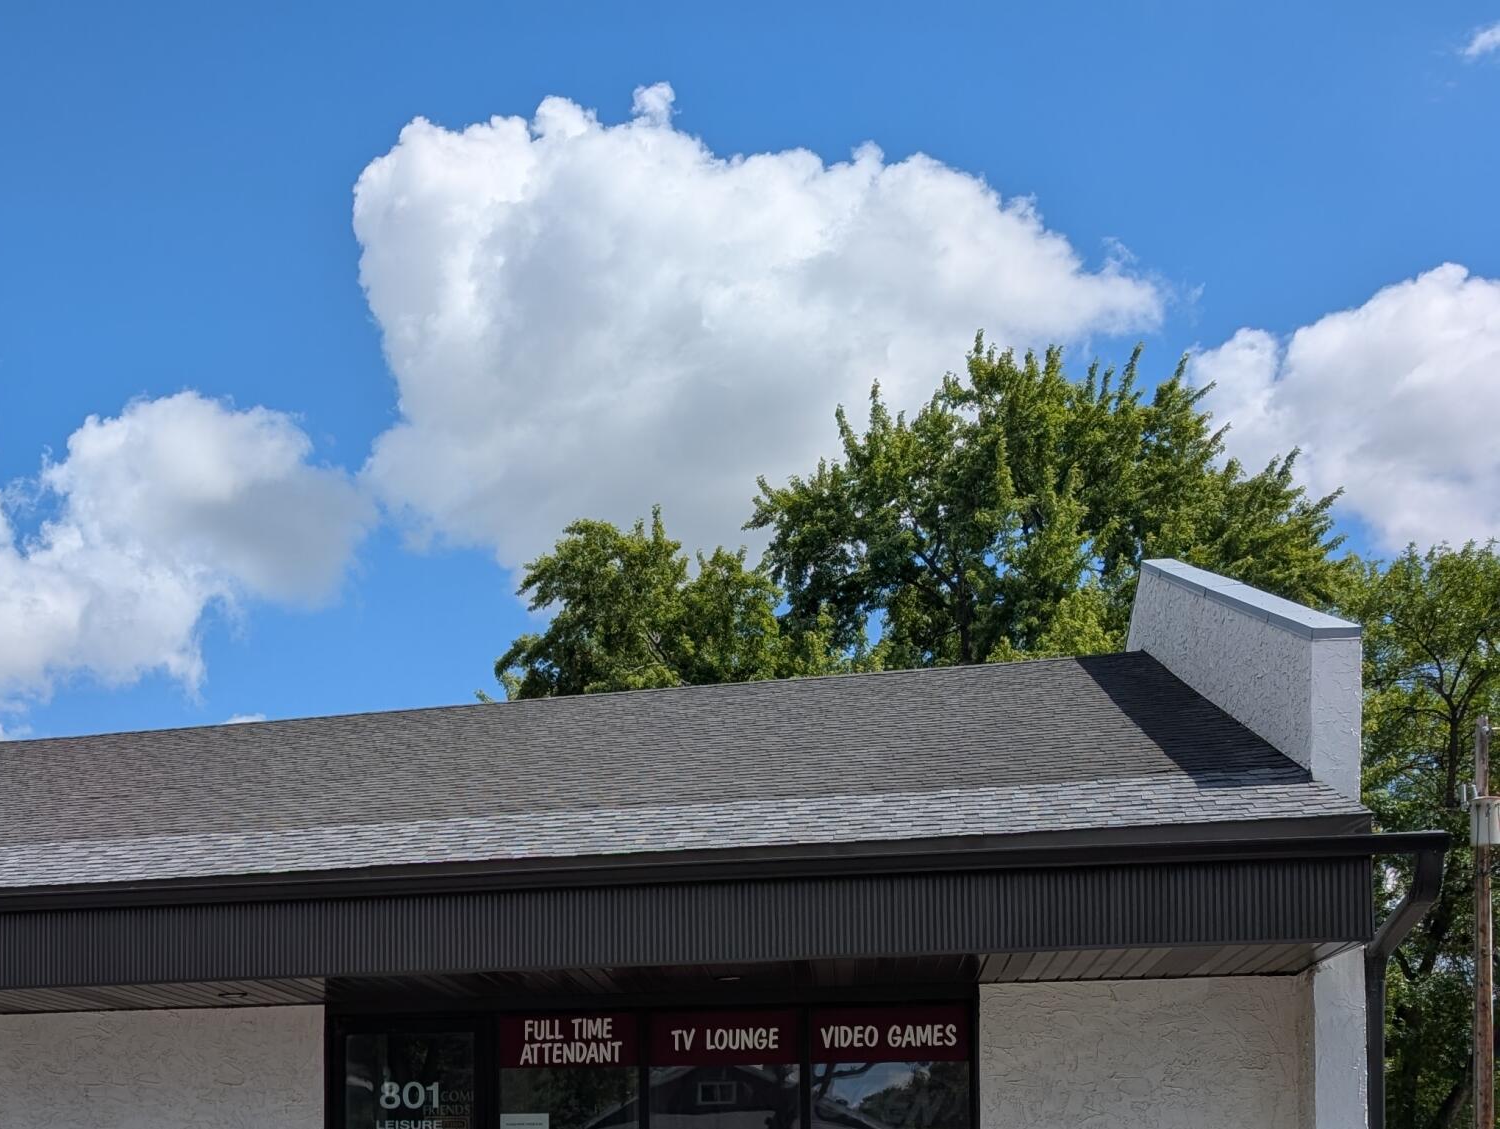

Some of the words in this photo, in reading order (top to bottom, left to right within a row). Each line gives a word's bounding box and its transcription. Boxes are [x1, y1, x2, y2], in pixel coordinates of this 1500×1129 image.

[524, 1019, 564, 1041] FULL
[571, 1018, 613, 1040] TIME
[671, 1028, 696, 1051] TV
[706, 1027, 779, 1050] LOUNGE
[820, 1025, 879, 1049] VIDEO
[887, 1023, 957, 1048] GAMES
[519, 1041, 623, 1066] ATTENDANT
[379, 1081, 439, 1110] 801
[376, 1120, 444, 1129] LEISURE
